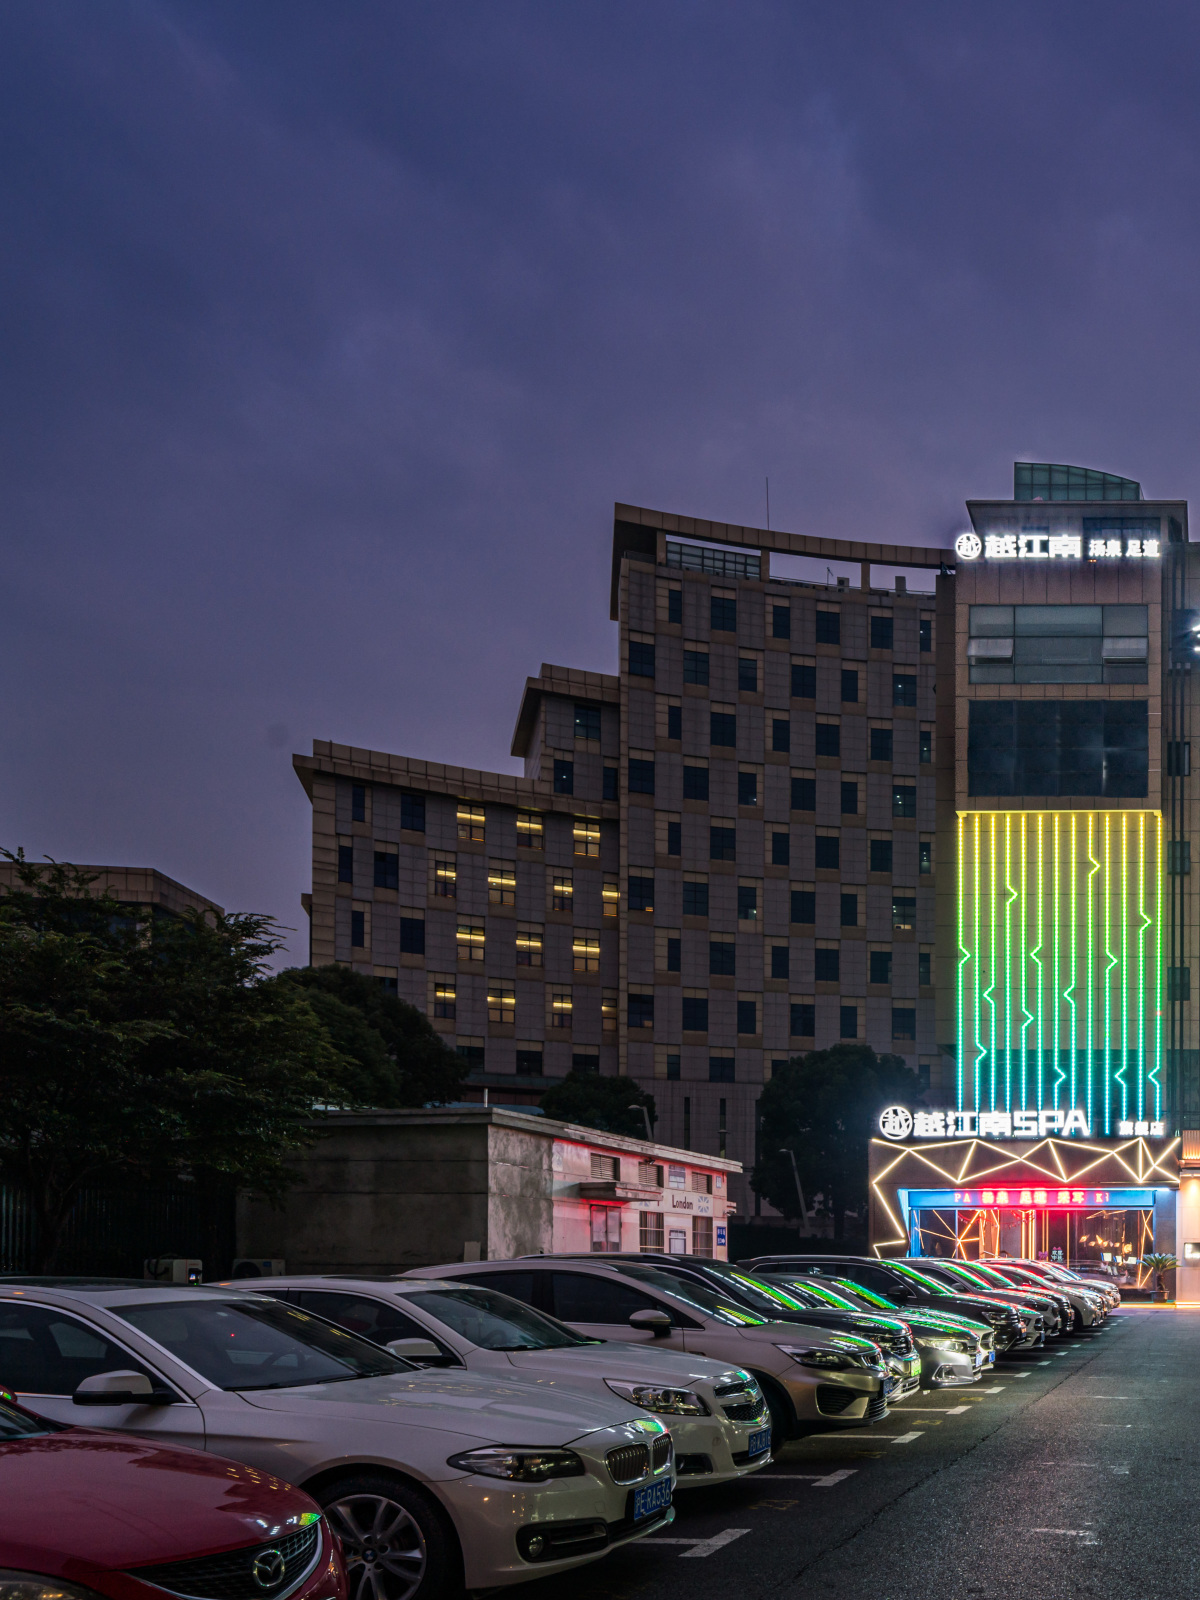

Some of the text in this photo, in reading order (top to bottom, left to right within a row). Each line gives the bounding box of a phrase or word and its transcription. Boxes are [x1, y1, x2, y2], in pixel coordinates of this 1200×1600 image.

[985, 534, 1081, 558] 越江南
[1126, 540, 1160, 558] 足道
[672, 1195, 693, 1210] London
